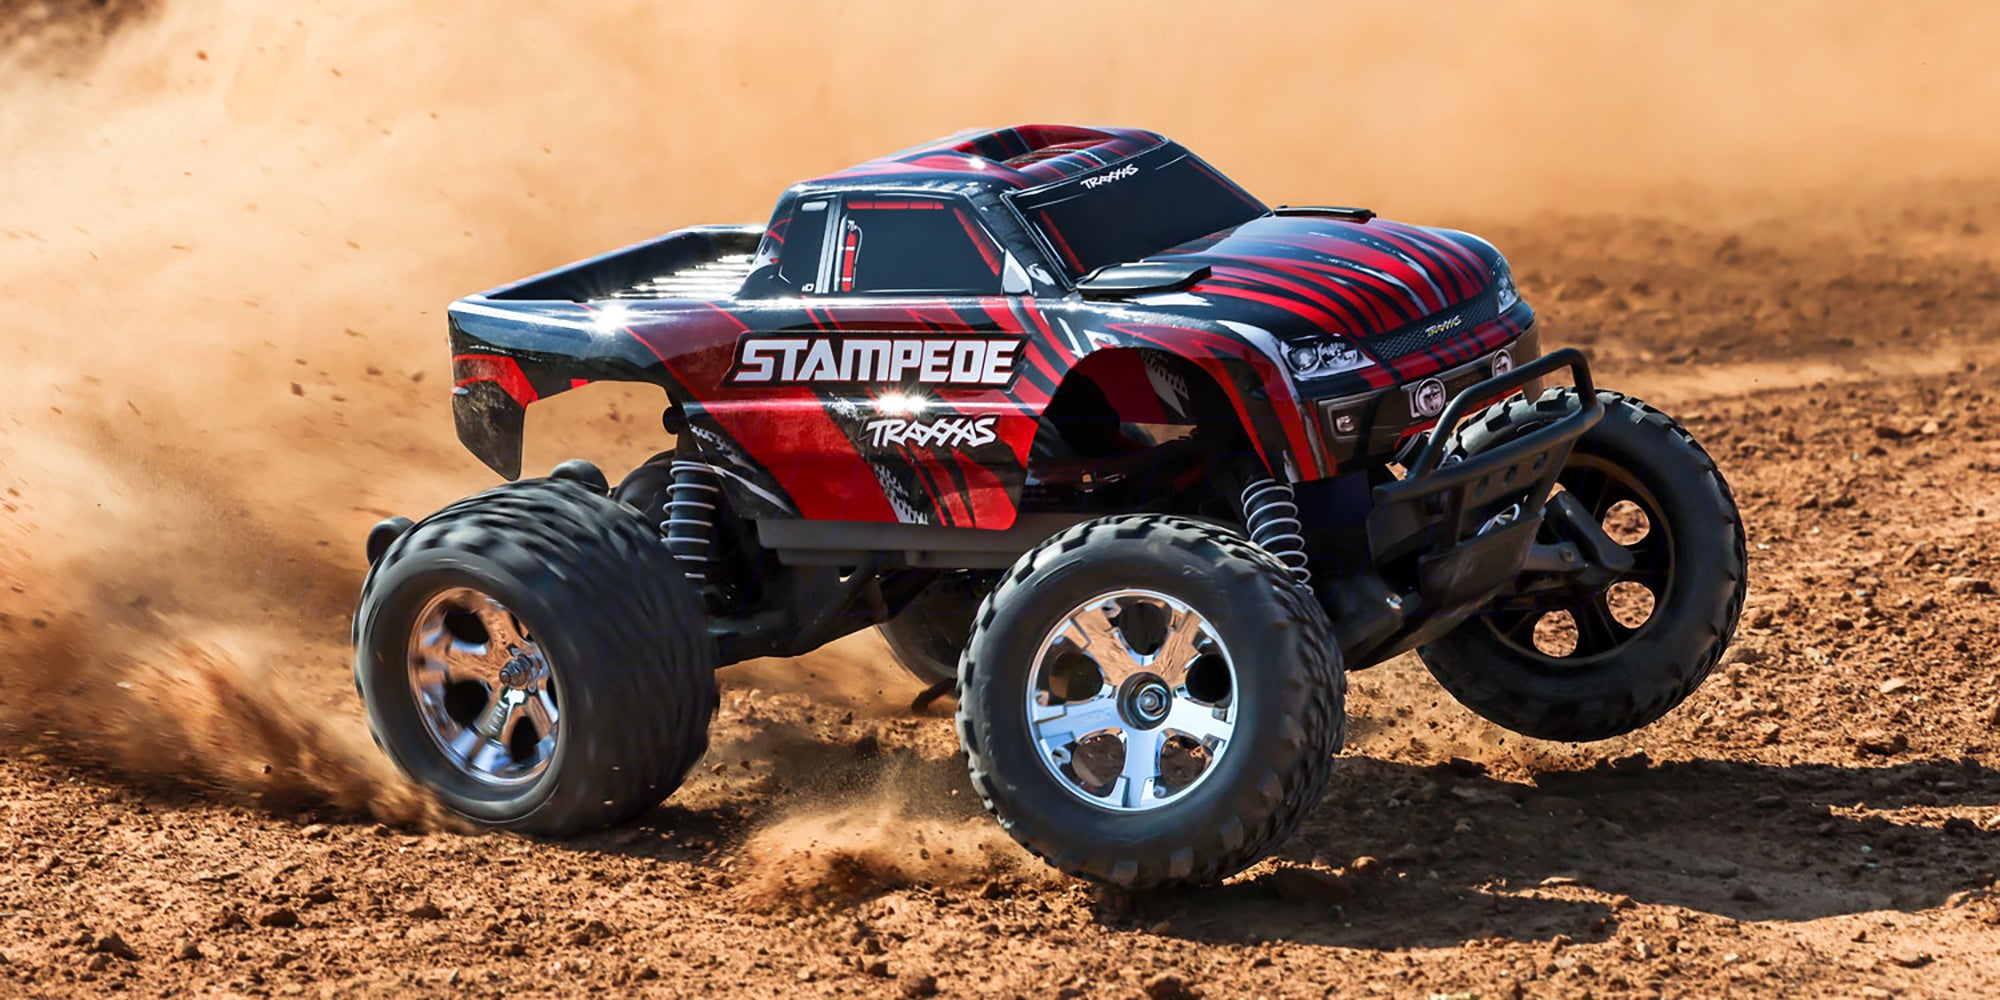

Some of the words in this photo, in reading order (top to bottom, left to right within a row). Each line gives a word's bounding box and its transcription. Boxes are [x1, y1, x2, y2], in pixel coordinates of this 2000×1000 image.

[1080, 163, 1139, 189] TRAXXAS
[733, 339, 1021, 384] STAMPEDE
[866, 416, 997, 448] TRAXXAS
